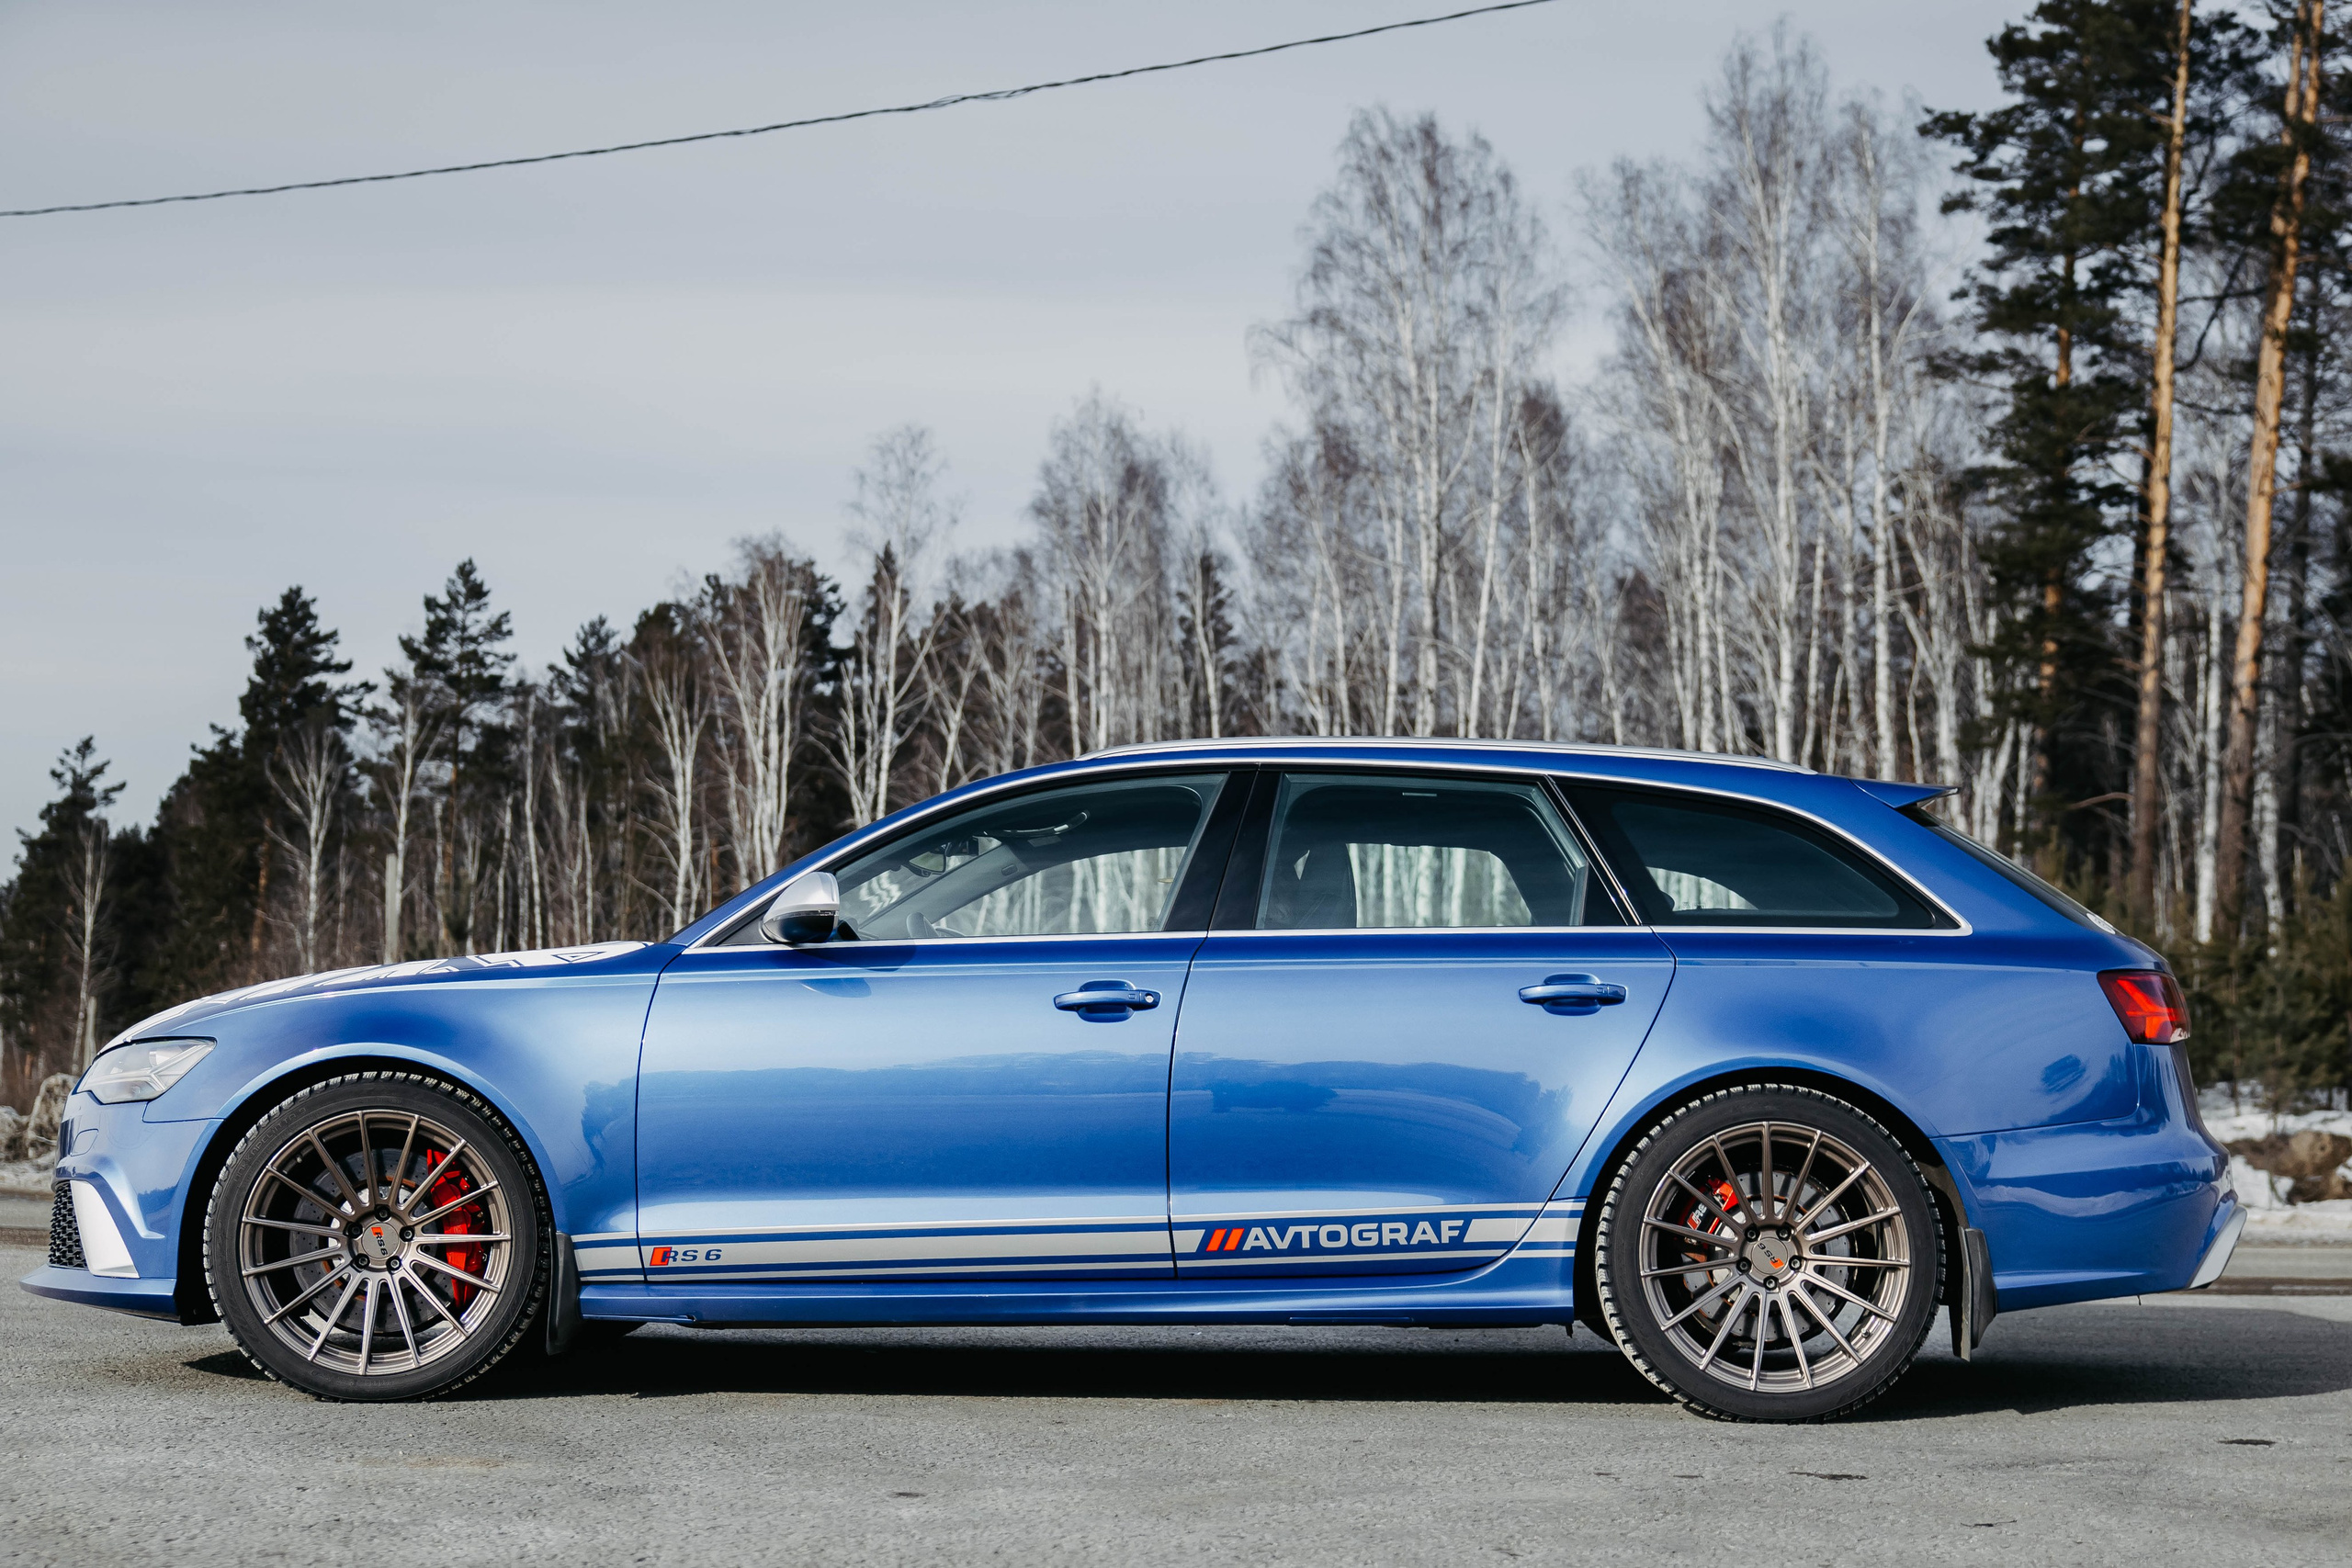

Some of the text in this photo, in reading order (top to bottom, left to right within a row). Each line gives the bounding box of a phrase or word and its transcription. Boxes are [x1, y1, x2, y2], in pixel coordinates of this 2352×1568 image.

[375, 1232, 386, 1247] RS
[659, 1248, 723, 1263] RS 6
